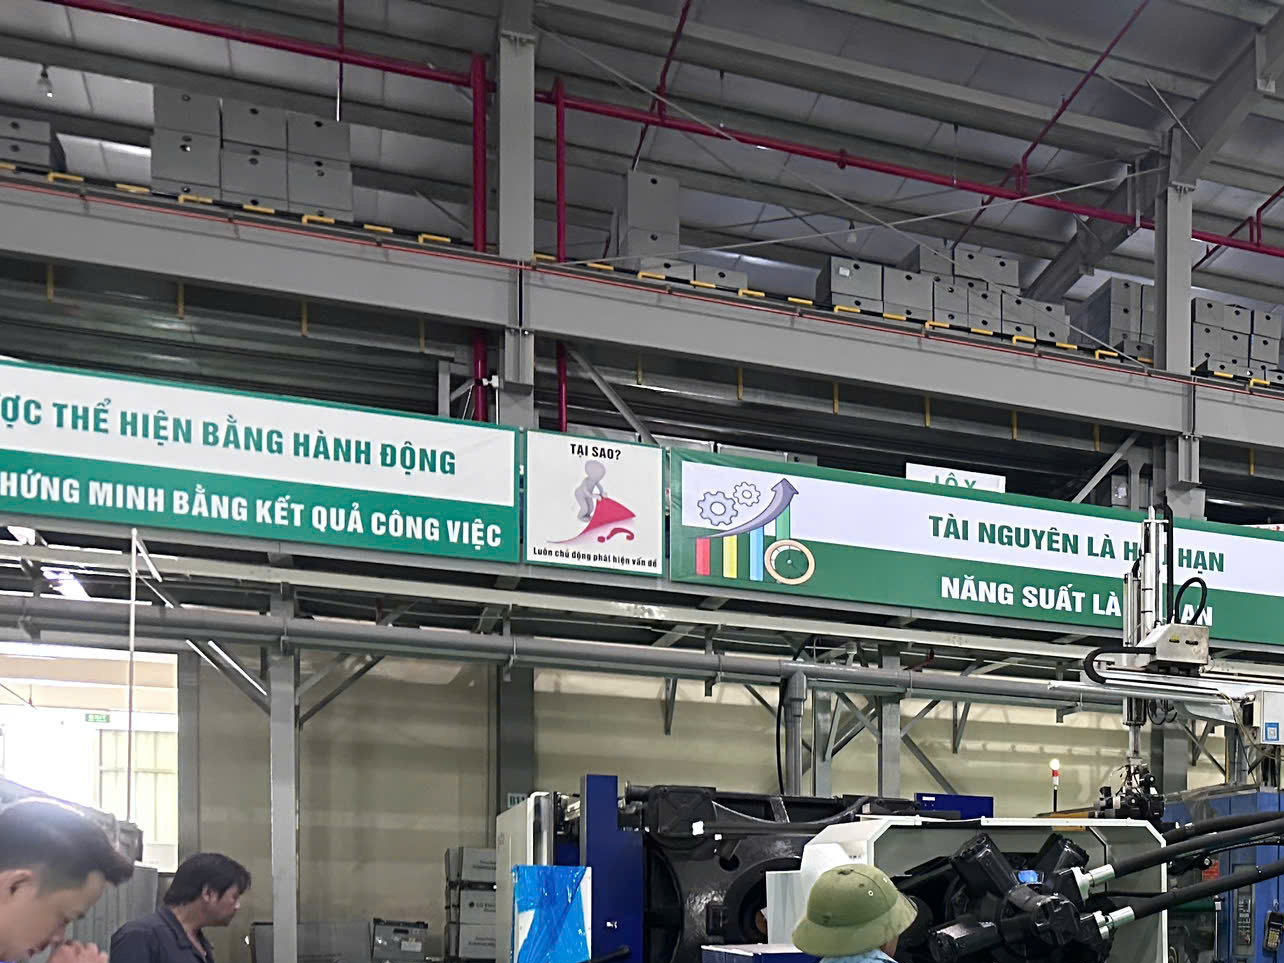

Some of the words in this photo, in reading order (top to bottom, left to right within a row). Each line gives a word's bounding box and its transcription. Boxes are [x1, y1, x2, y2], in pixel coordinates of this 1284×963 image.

[53, 398, 111, 434] THỂ
[120, 410, 192, 446] HIỆN
[202, 414, 284, 455] BẰNG
[293, 430, 371, 465] HÀNH
[380, 441, 456, 475] ĐỘNG
[570, 443, 588, 458] TẠI
[592, 446, 621, 460] SAO?
[89, 480, 164, 513] MINH
[173, 484, 248, 521] BẰNG
[256, 495, 304, 527] KẾT
[312, 502, 364, 534] QUẢ
[371, 510, 440, 542] CÔNG
[447, 519, 501, 550] VIỆC
[929, 513, 969, 541] TÀI
[978, 522, 1079, 554] NGUYÊN
[1087, 534, 1116, 559] LÀ
[1178, 548, 1224, 574] HẠN
[941, 574, 1014, 606] NĂNG
[1022, 584, 1086, 613] SUẤT
[1092, 592, 1122, 616] LÀ
